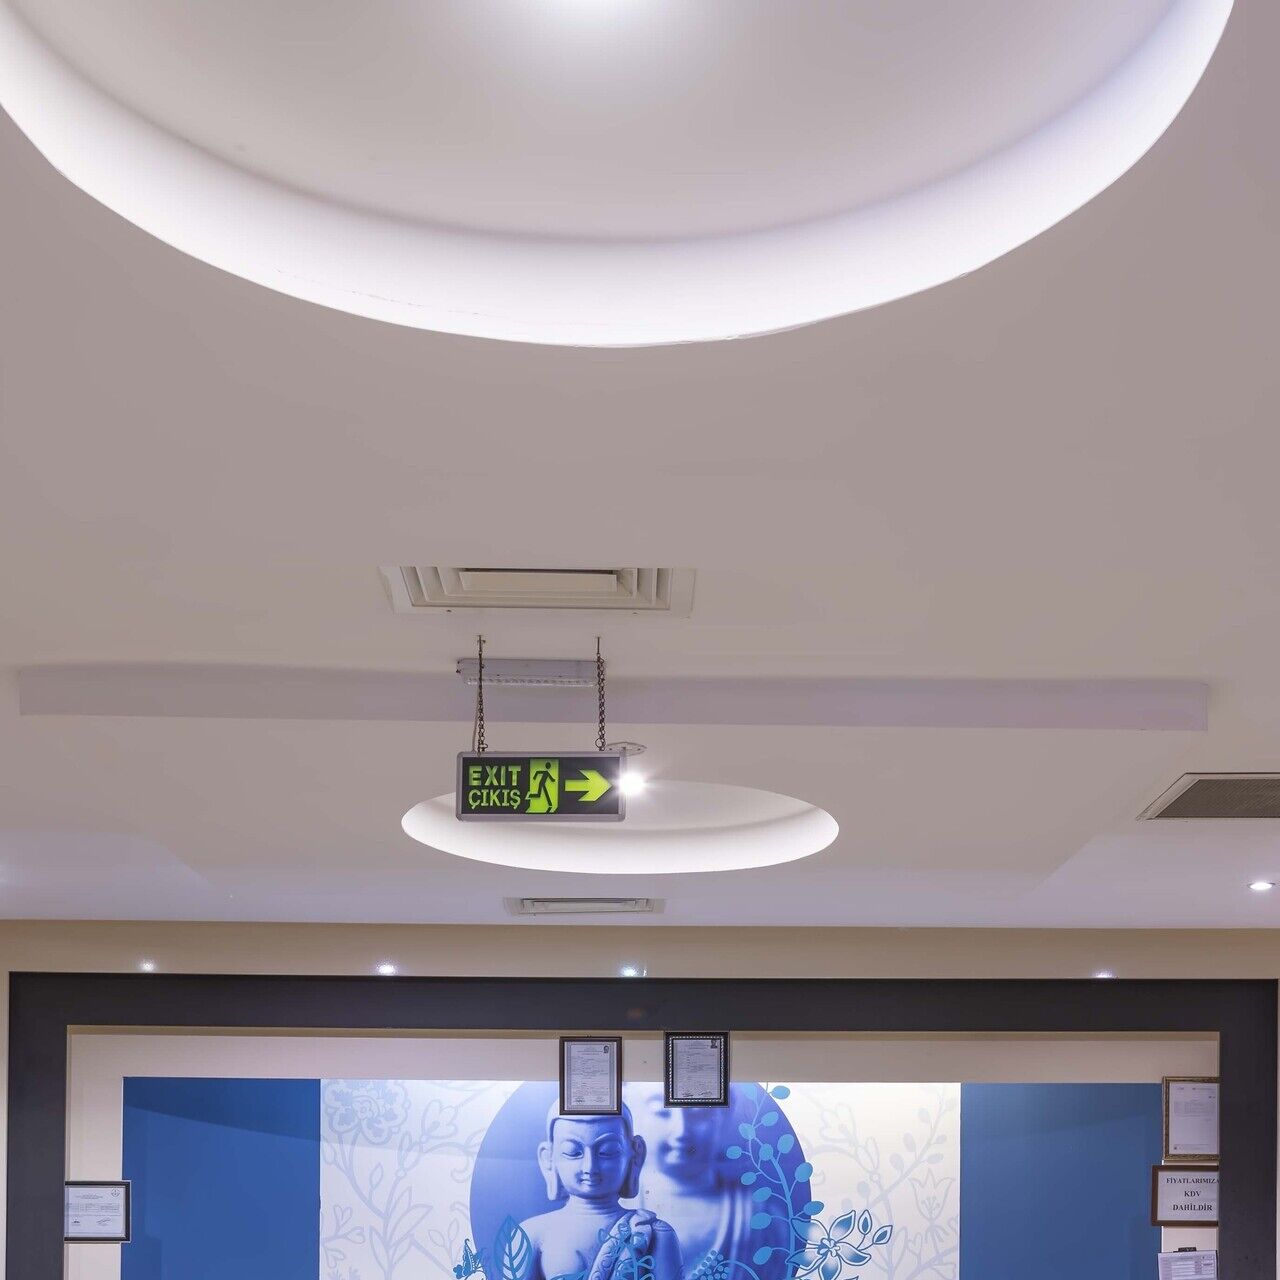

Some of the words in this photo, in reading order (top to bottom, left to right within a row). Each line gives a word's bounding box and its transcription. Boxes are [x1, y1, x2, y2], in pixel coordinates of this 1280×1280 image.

[468, 766, 522, 786] EXIT
[468, 789, 521, 810] ÇIKIŞ
[1172, 1202, 1213, 1211] DAHİLDİR
